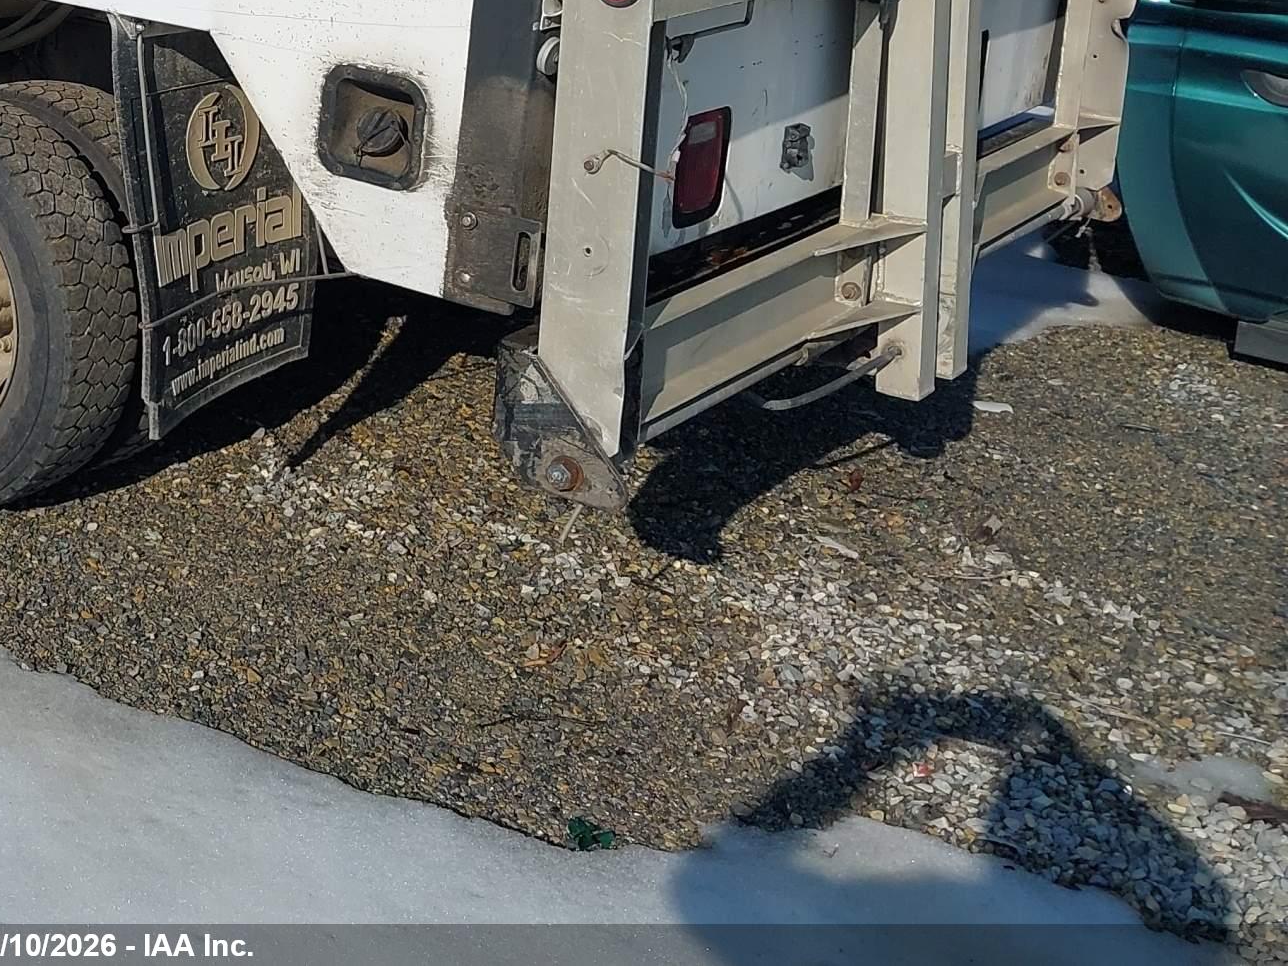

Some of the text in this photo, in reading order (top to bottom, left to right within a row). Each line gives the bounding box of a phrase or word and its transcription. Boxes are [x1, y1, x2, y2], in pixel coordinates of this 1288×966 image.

[152, 181, 303, 294] Imperial
[279, 247, 301, 276] WI
[162, 283, 300, 367] 1-800-558-2945
[171, 326, 285, 397] www.imperialind.com
